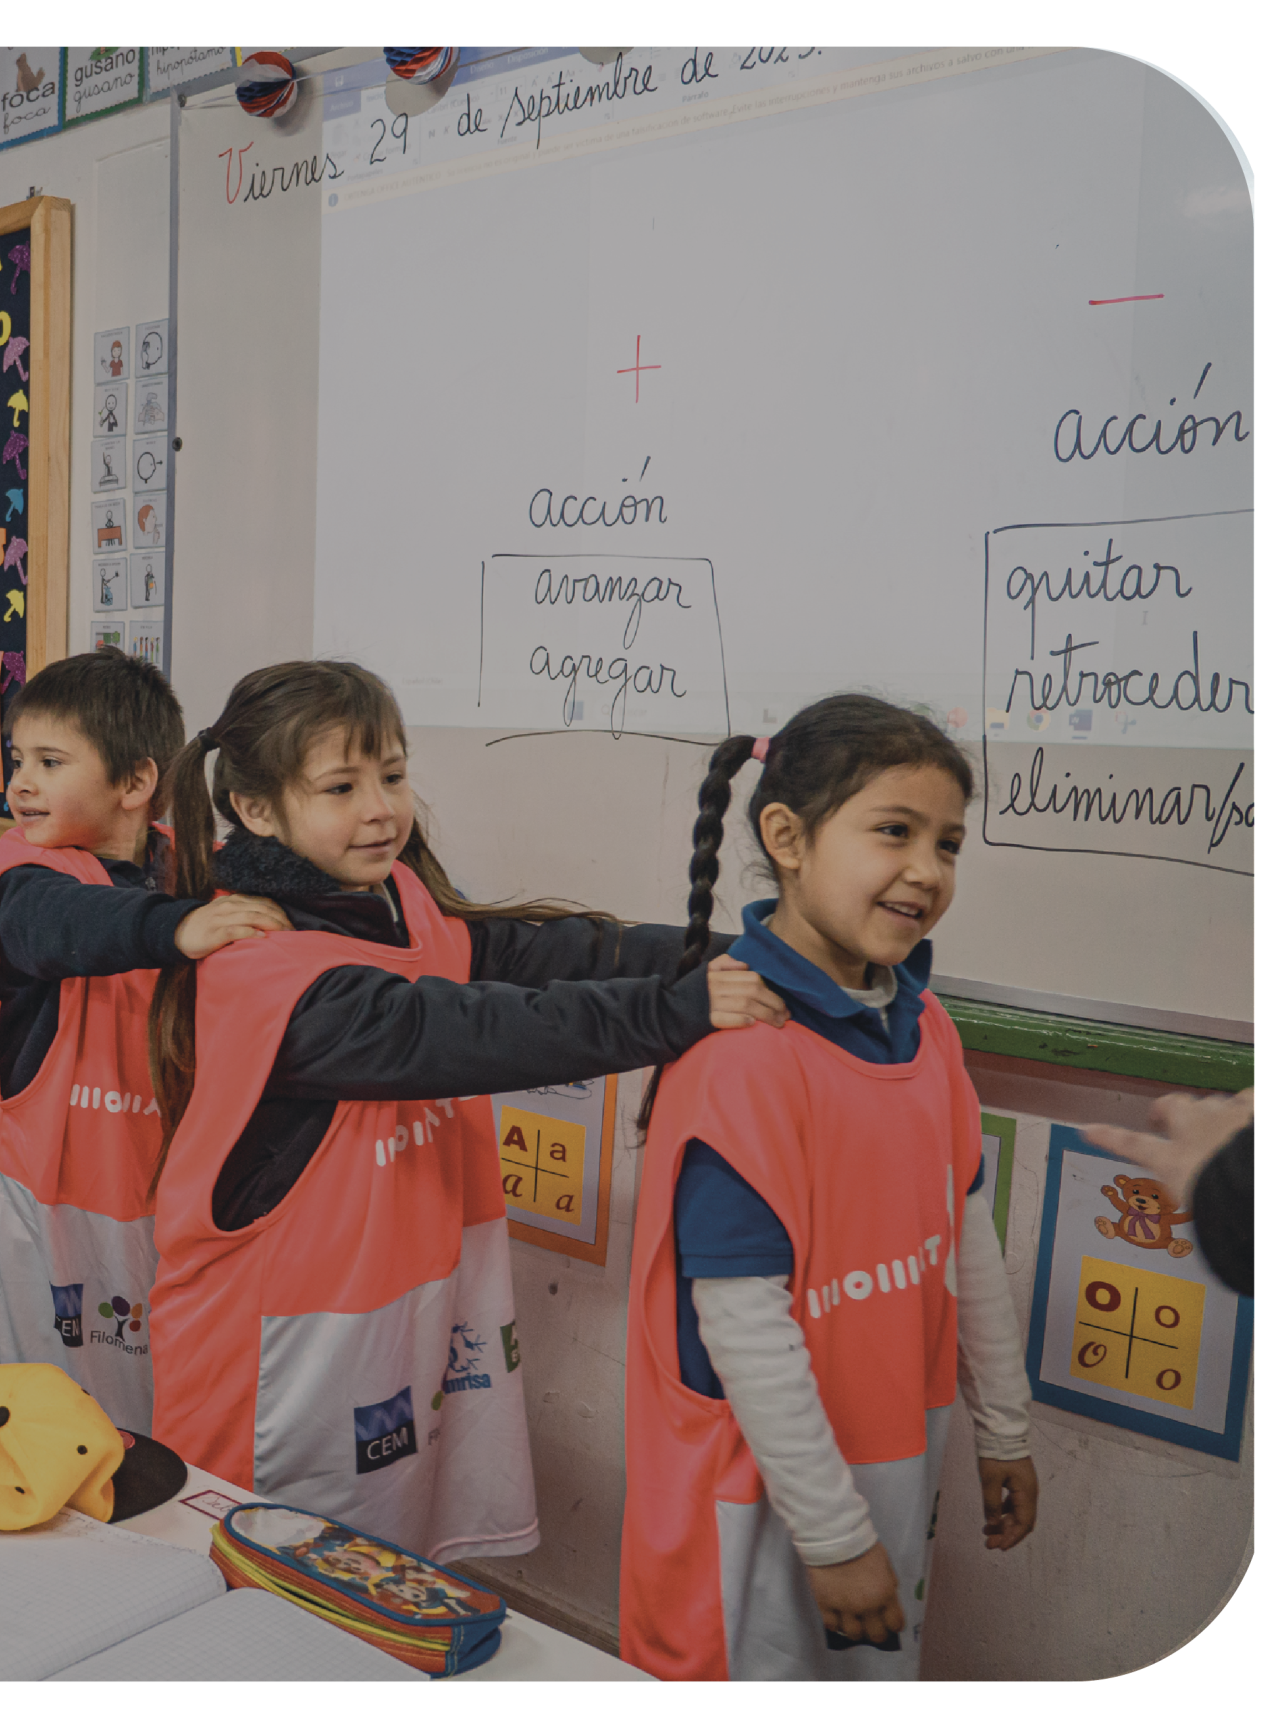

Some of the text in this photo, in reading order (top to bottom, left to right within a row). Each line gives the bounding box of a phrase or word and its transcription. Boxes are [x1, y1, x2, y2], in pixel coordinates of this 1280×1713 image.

[74, 48, 136, 86] gusano
[906, 60, 946, 77] archivos
[956, 52, 982, 66] salvo
[1, 81, 56, 112] foca
[73, 71, 135, 113] gusano
[3, 106, 52, 134] foca
[218, 141, 345, 204] Viernes
[370, 112, 408, 166] 29
[457, 93, 488, 136] de
[500, 51, 658, 150] septiembre
[681, 46, 720, 85] de
[1054, 361, 1251, 463] acción
[529, 456, 668, 528] acción
[535, 568, 692, 650] avanzar
[1007, 538, 1193, 661] quitar
[530, 646, 687, 740] agregar
[1005, 630, 1255, 714] retroceder
[502, 1124, 568, 1163] A a
[501, 1173, 575, 1213] a a
[1084, 1280, 1181, 1329] O o
[90, 1330, 149, 1357] Filomena
[367, 1434, 409, 1461] CEM
